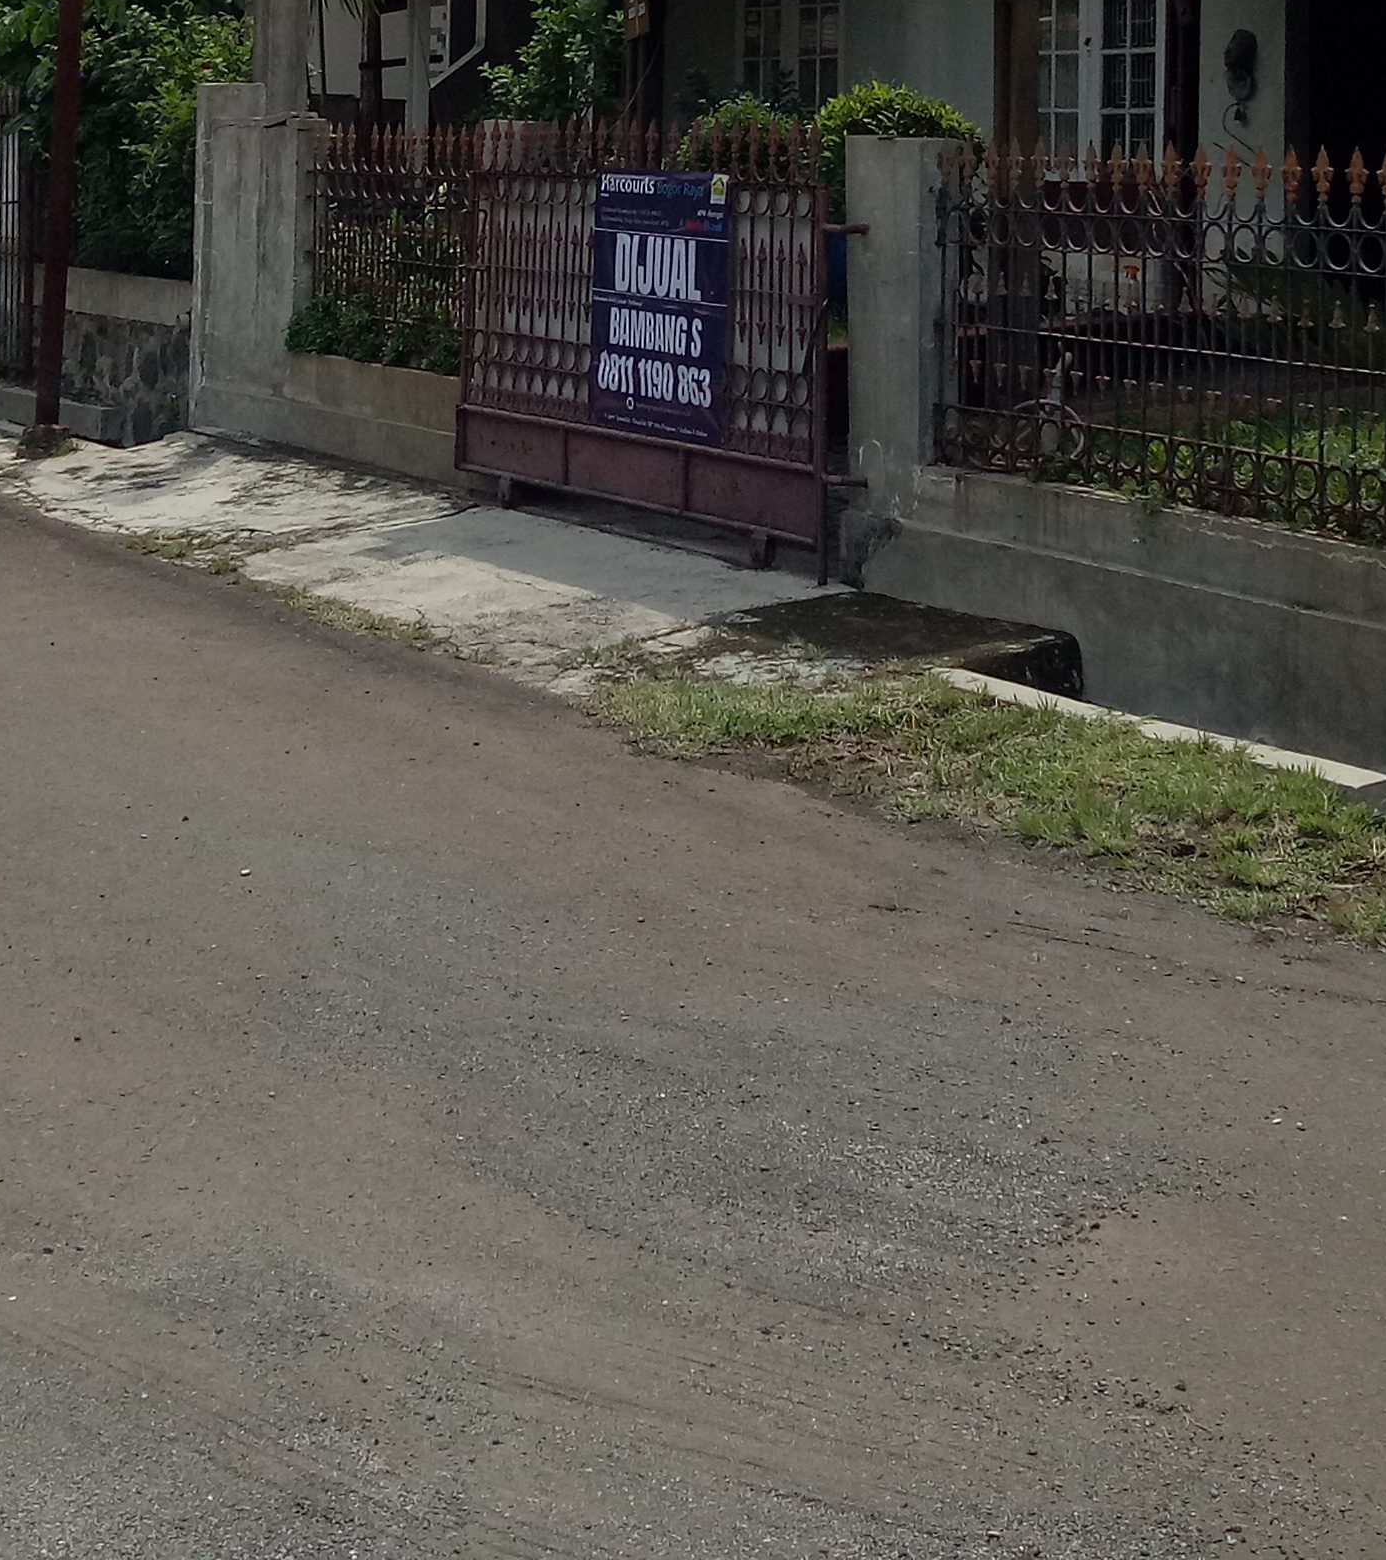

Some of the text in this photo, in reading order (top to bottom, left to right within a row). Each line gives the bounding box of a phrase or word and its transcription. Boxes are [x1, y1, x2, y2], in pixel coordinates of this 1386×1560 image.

[600, 173, 655, 196] Harcourts
[614, 233, 701, 301] DIJUAL
[609, 307, 702, 358] BAMBANG S
[597, 351, 712, 409] 0811 1190 863
